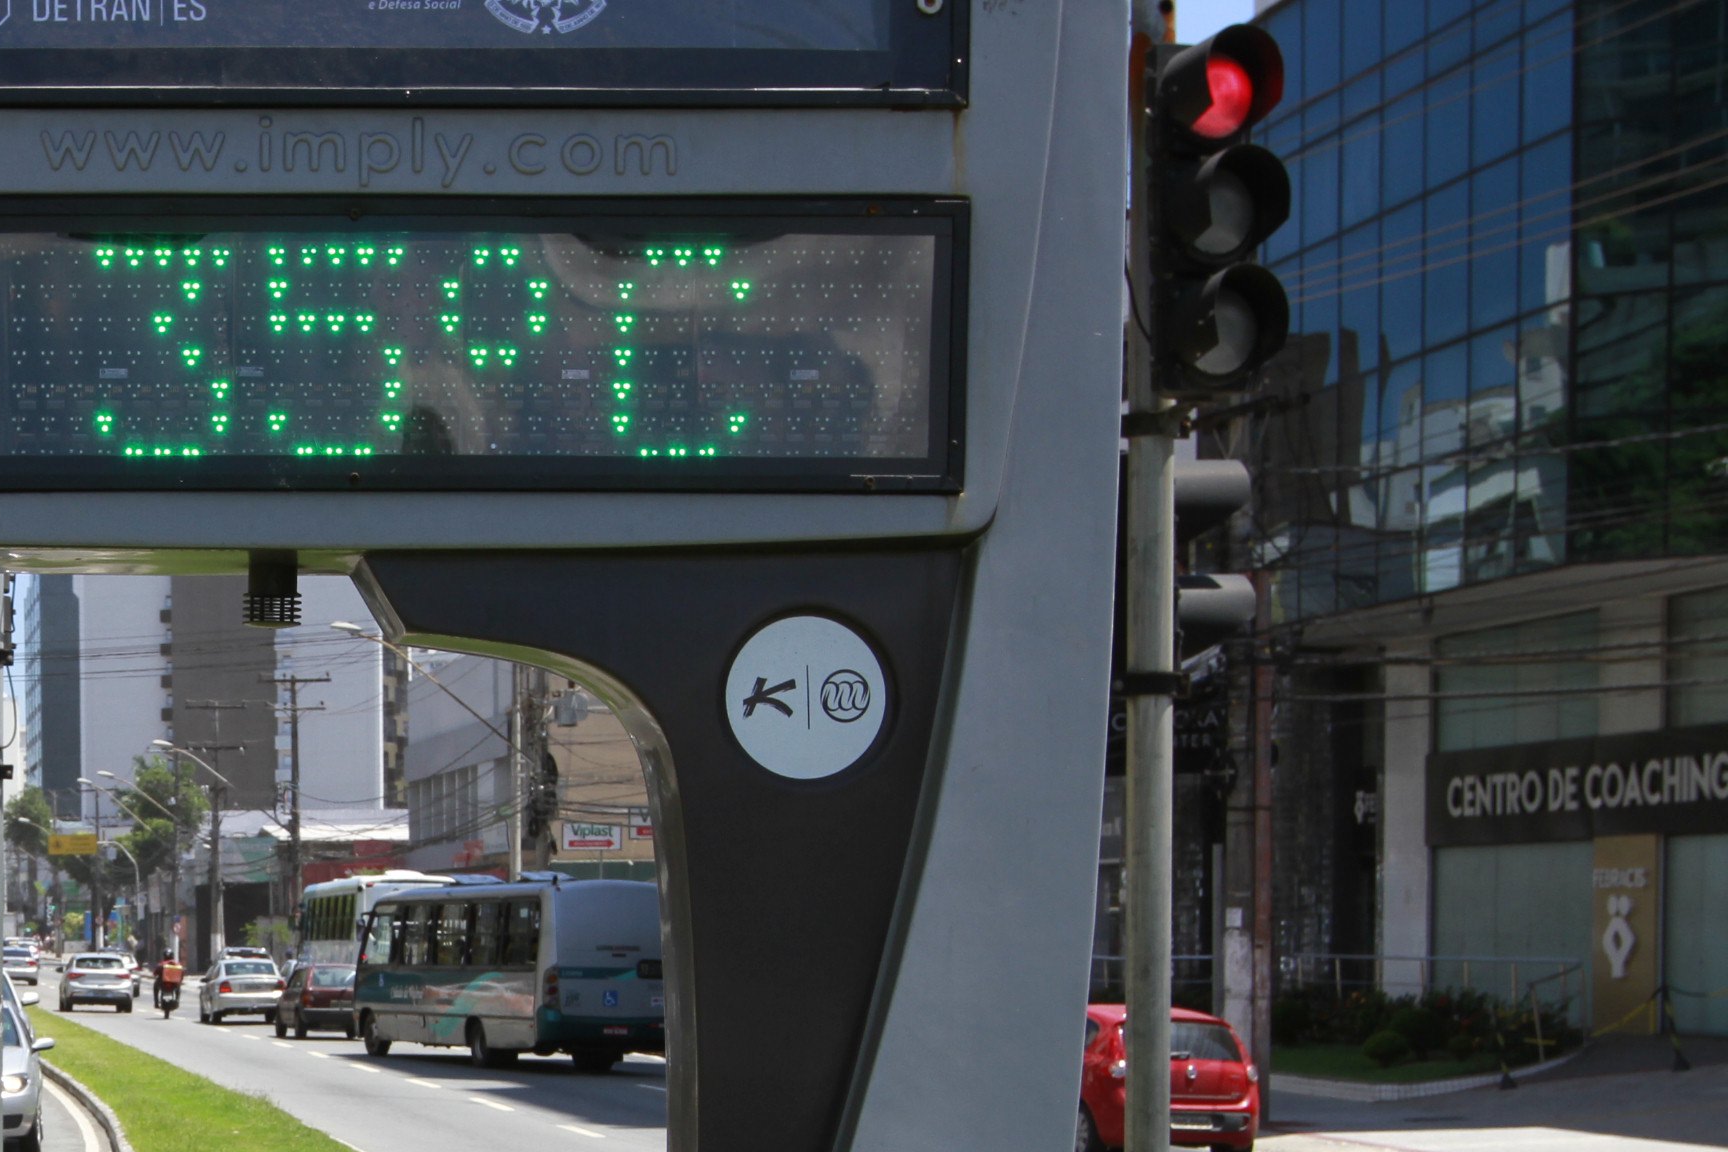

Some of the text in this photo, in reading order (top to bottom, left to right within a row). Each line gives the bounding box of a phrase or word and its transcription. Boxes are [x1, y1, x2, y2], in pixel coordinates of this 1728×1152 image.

[377, 0, 422, 9] Defesa
[423, 0, 462, 9] Social
[40, 116, 677, 188] www.imply.com
[1447, 751, 1728, 818] CENTRO DE COACHING
[571, 824, 613, 839] Viplast
